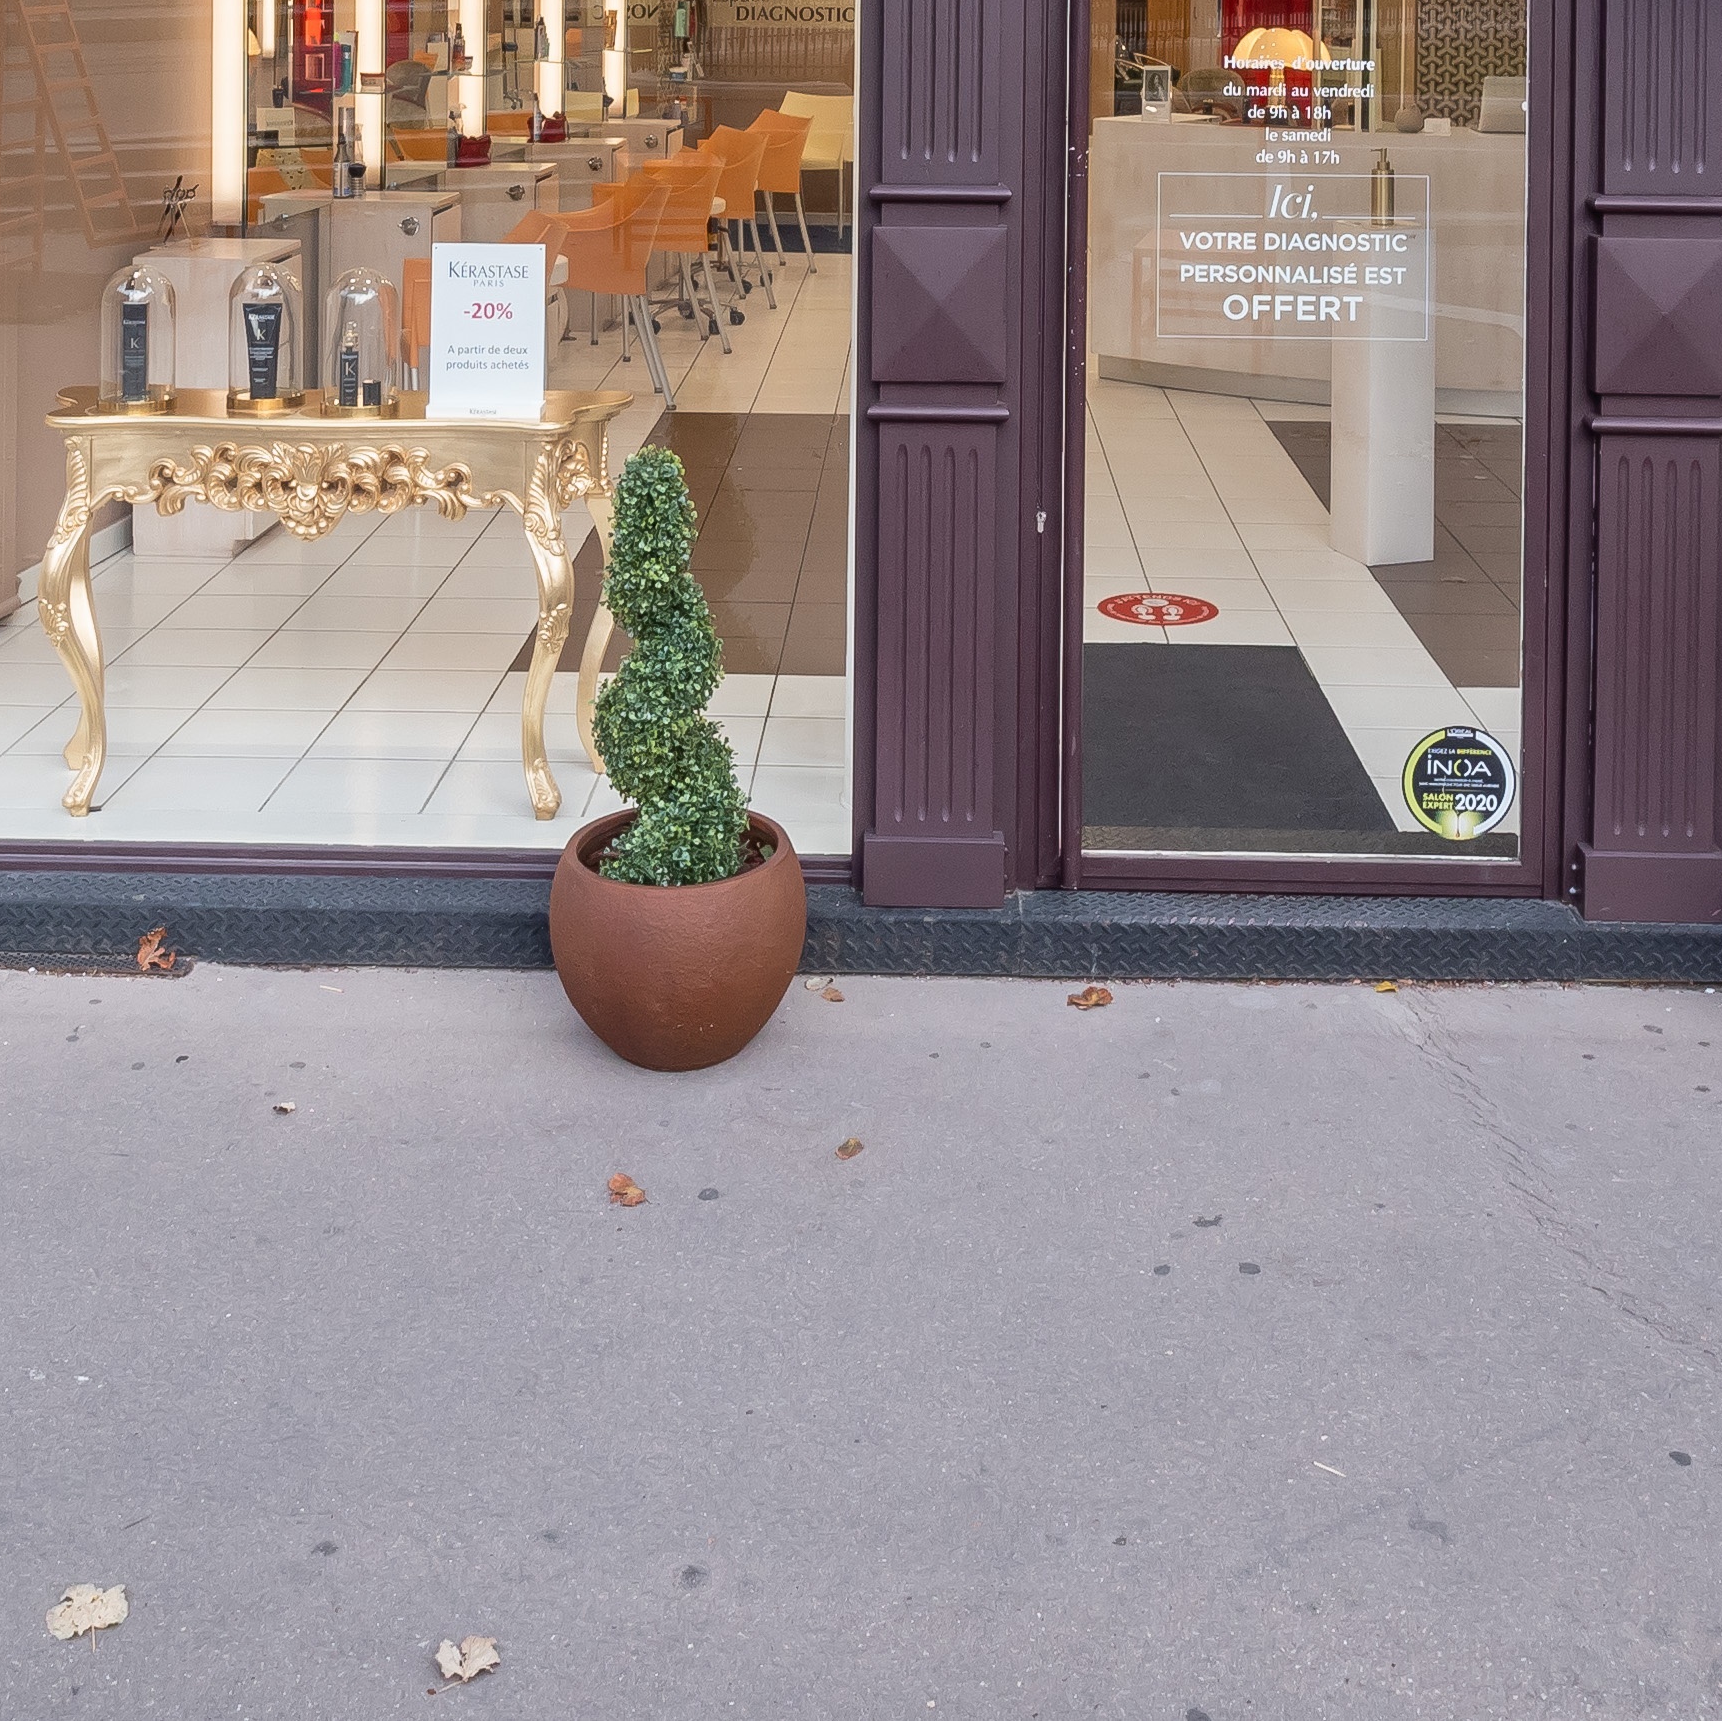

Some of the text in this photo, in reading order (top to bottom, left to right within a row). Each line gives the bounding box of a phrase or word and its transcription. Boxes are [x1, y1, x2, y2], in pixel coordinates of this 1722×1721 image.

[735, 5, 855, 23] DIAGNOSTIC
[1222, 55, 1376, 71] Horaires d'ouverture
[1222, 82, 1375, 98] du mardi au vendredi
[1247, 105, 1332, 120] de 9h à 18h
[1265, 128, 1332, 143] le samedi
[1255, 149, 1340, 164] de 9h à 17h
[1268, 184, 1319, 223] Ici,
[1180, 231, 1408, 252] VOTRE DIAGNOSTIC
[448, 260, 529, 279] KÉRASTASE
[1180, 262, 1407, 285] PERSONNALISÉ EST
[473, 279, 505, 288] PARIS
[463, 302, 513, 320] -20%
[1222, 294, 1364, 322] OFFERT
[447, 345, 528, 357] A partir de deux
[446, 359, 530, 372] produits achetés
[1422, 793, 1454, 802] SALON
[1422, 801, 1454, 810] EXPERT
[1454, 793, 1498, 812] 2020
